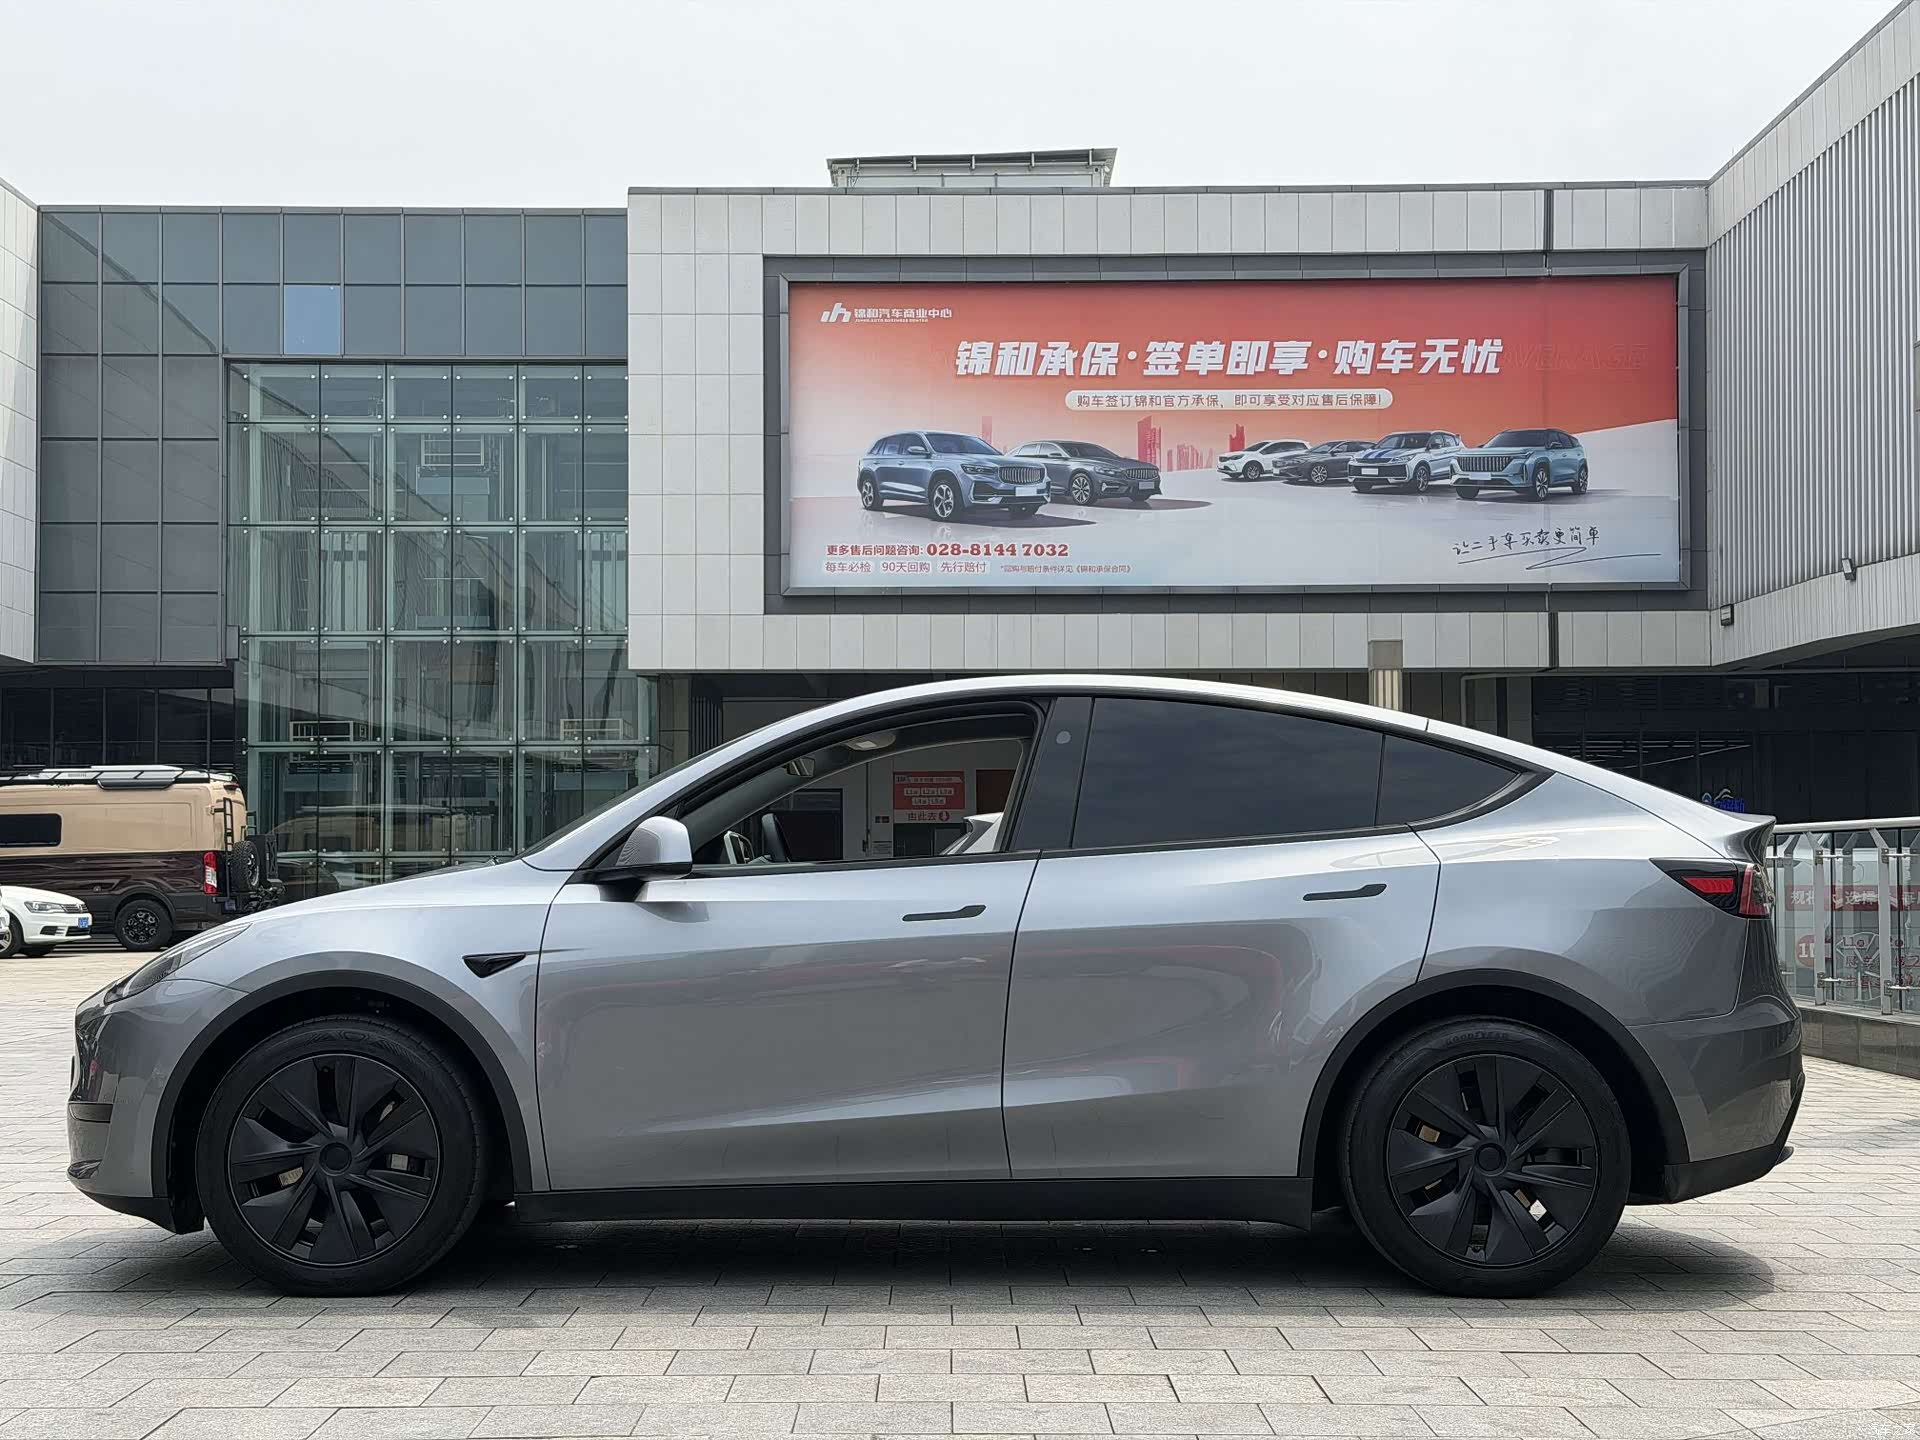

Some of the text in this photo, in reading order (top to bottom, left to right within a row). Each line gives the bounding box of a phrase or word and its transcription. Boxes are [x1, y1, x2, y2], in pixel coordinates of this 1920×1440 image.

[854, 308, 953, 319] 锦和汽车商业中心
[1022, 543, 1069, 557] 7032
[825, 561, 987, 573] 每车必检 90天回购 先行赔付
